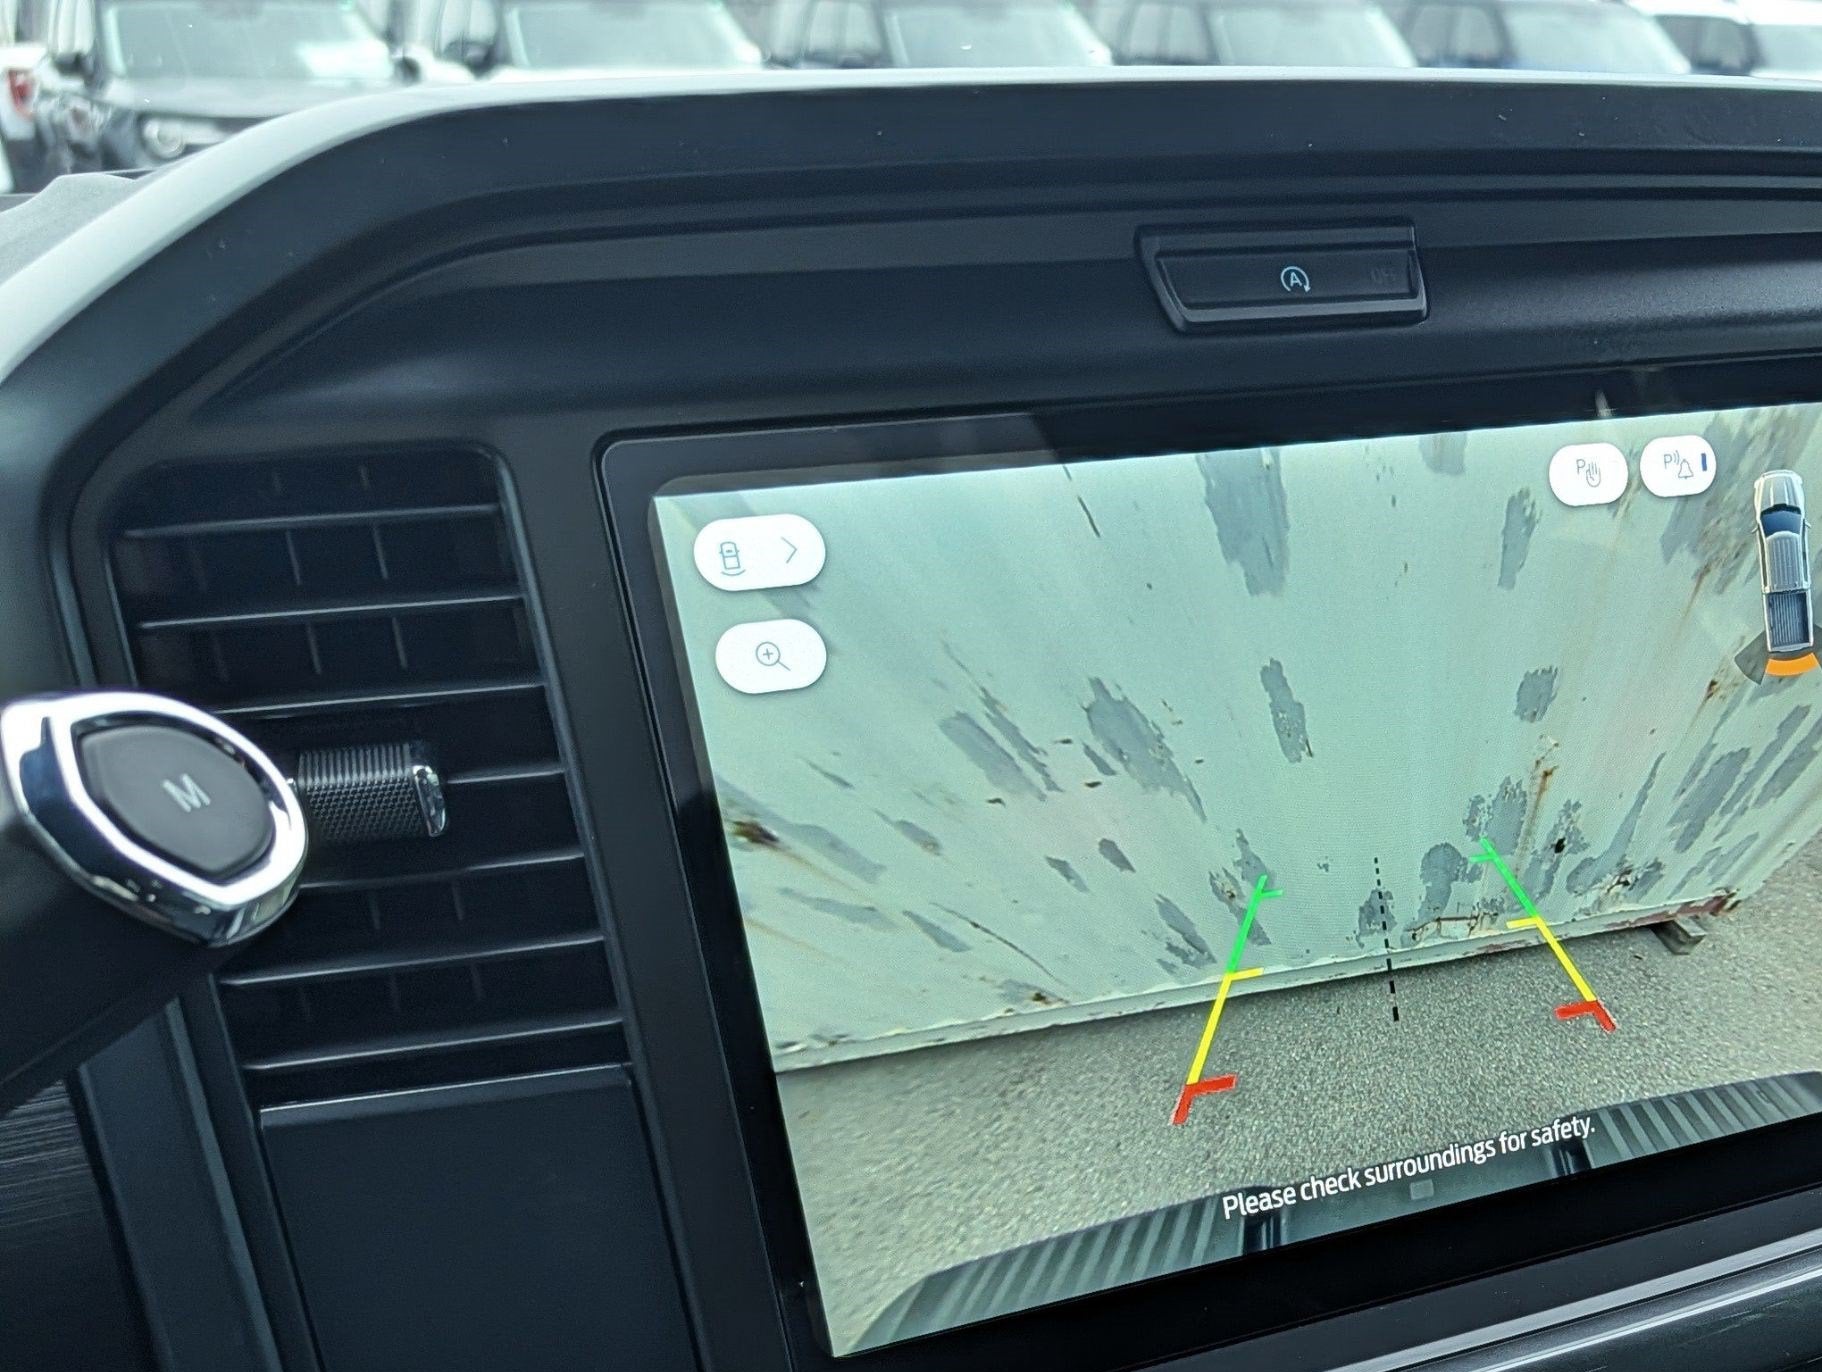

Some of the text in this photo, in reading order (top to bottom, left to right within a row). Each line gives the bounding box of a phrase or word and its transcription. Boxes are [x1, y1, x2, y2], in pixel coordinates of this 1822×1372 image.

[163, 773, 210, 812] M
[1222, 1114, 1597, 1220] Please check surroundings for safety.
